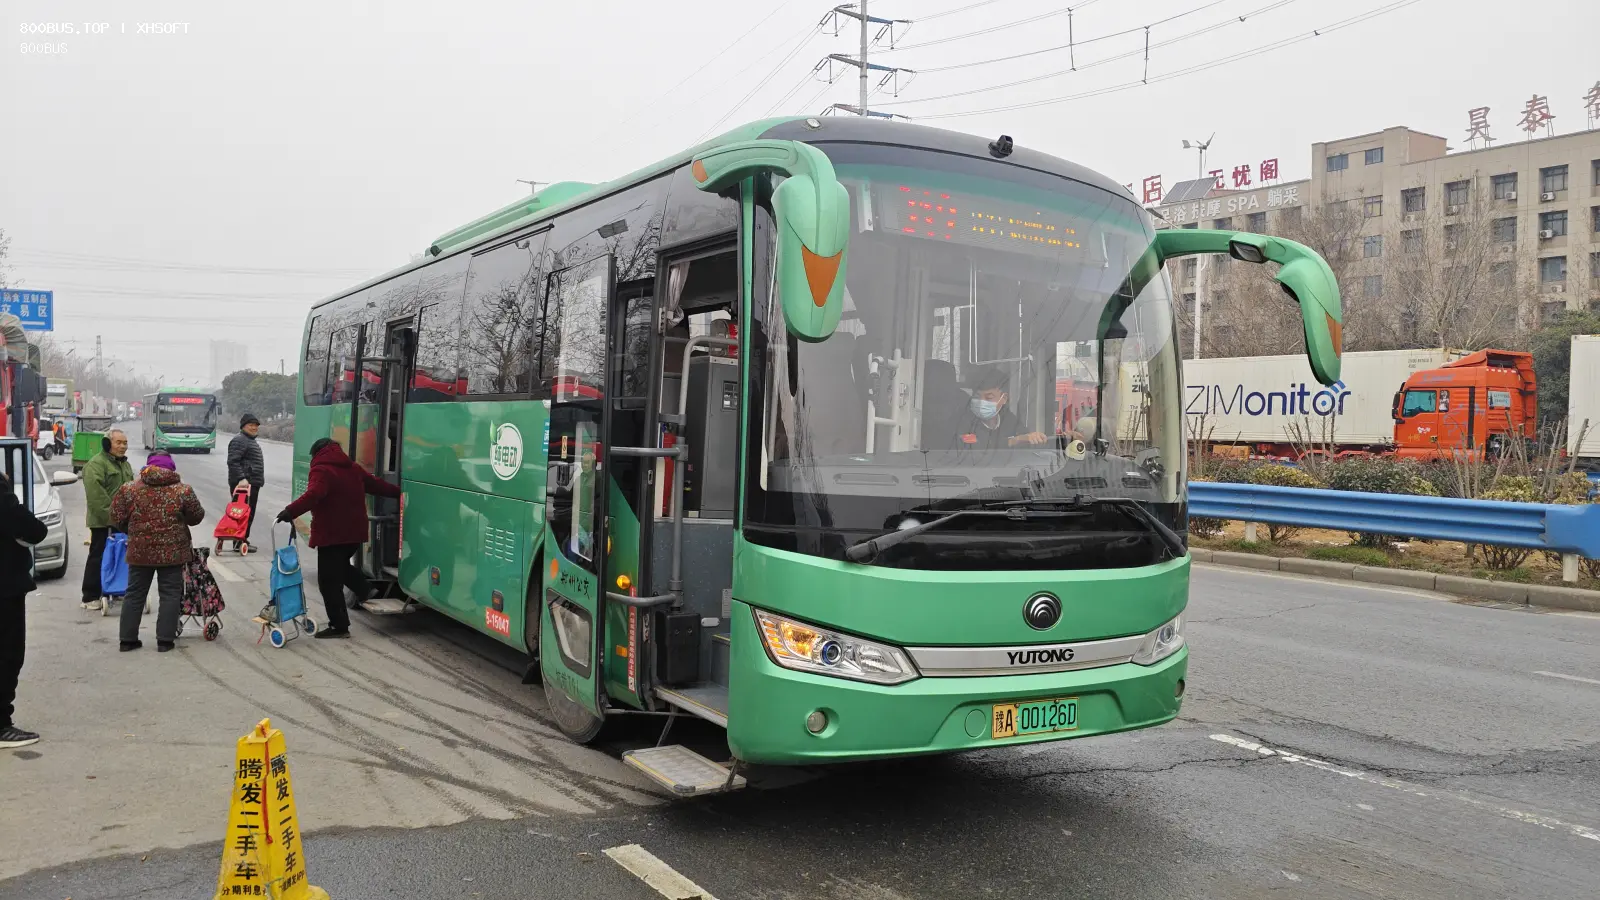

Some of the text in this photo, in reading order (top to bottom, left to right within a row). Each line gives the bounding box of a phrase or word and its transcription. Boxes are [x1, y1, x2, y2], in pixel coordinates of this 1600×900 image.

[1152, 205, 1187, 226] 足浴
[1227, 194, 1260, 213] SPA
[1185, 383, 1352, 416] ZIMonitor
[1007, 648, 1075, 665] YUTONG
[234, 758, 263, 880] 腾发二手车
[270, 754, 297, 873] 腾发二手车
